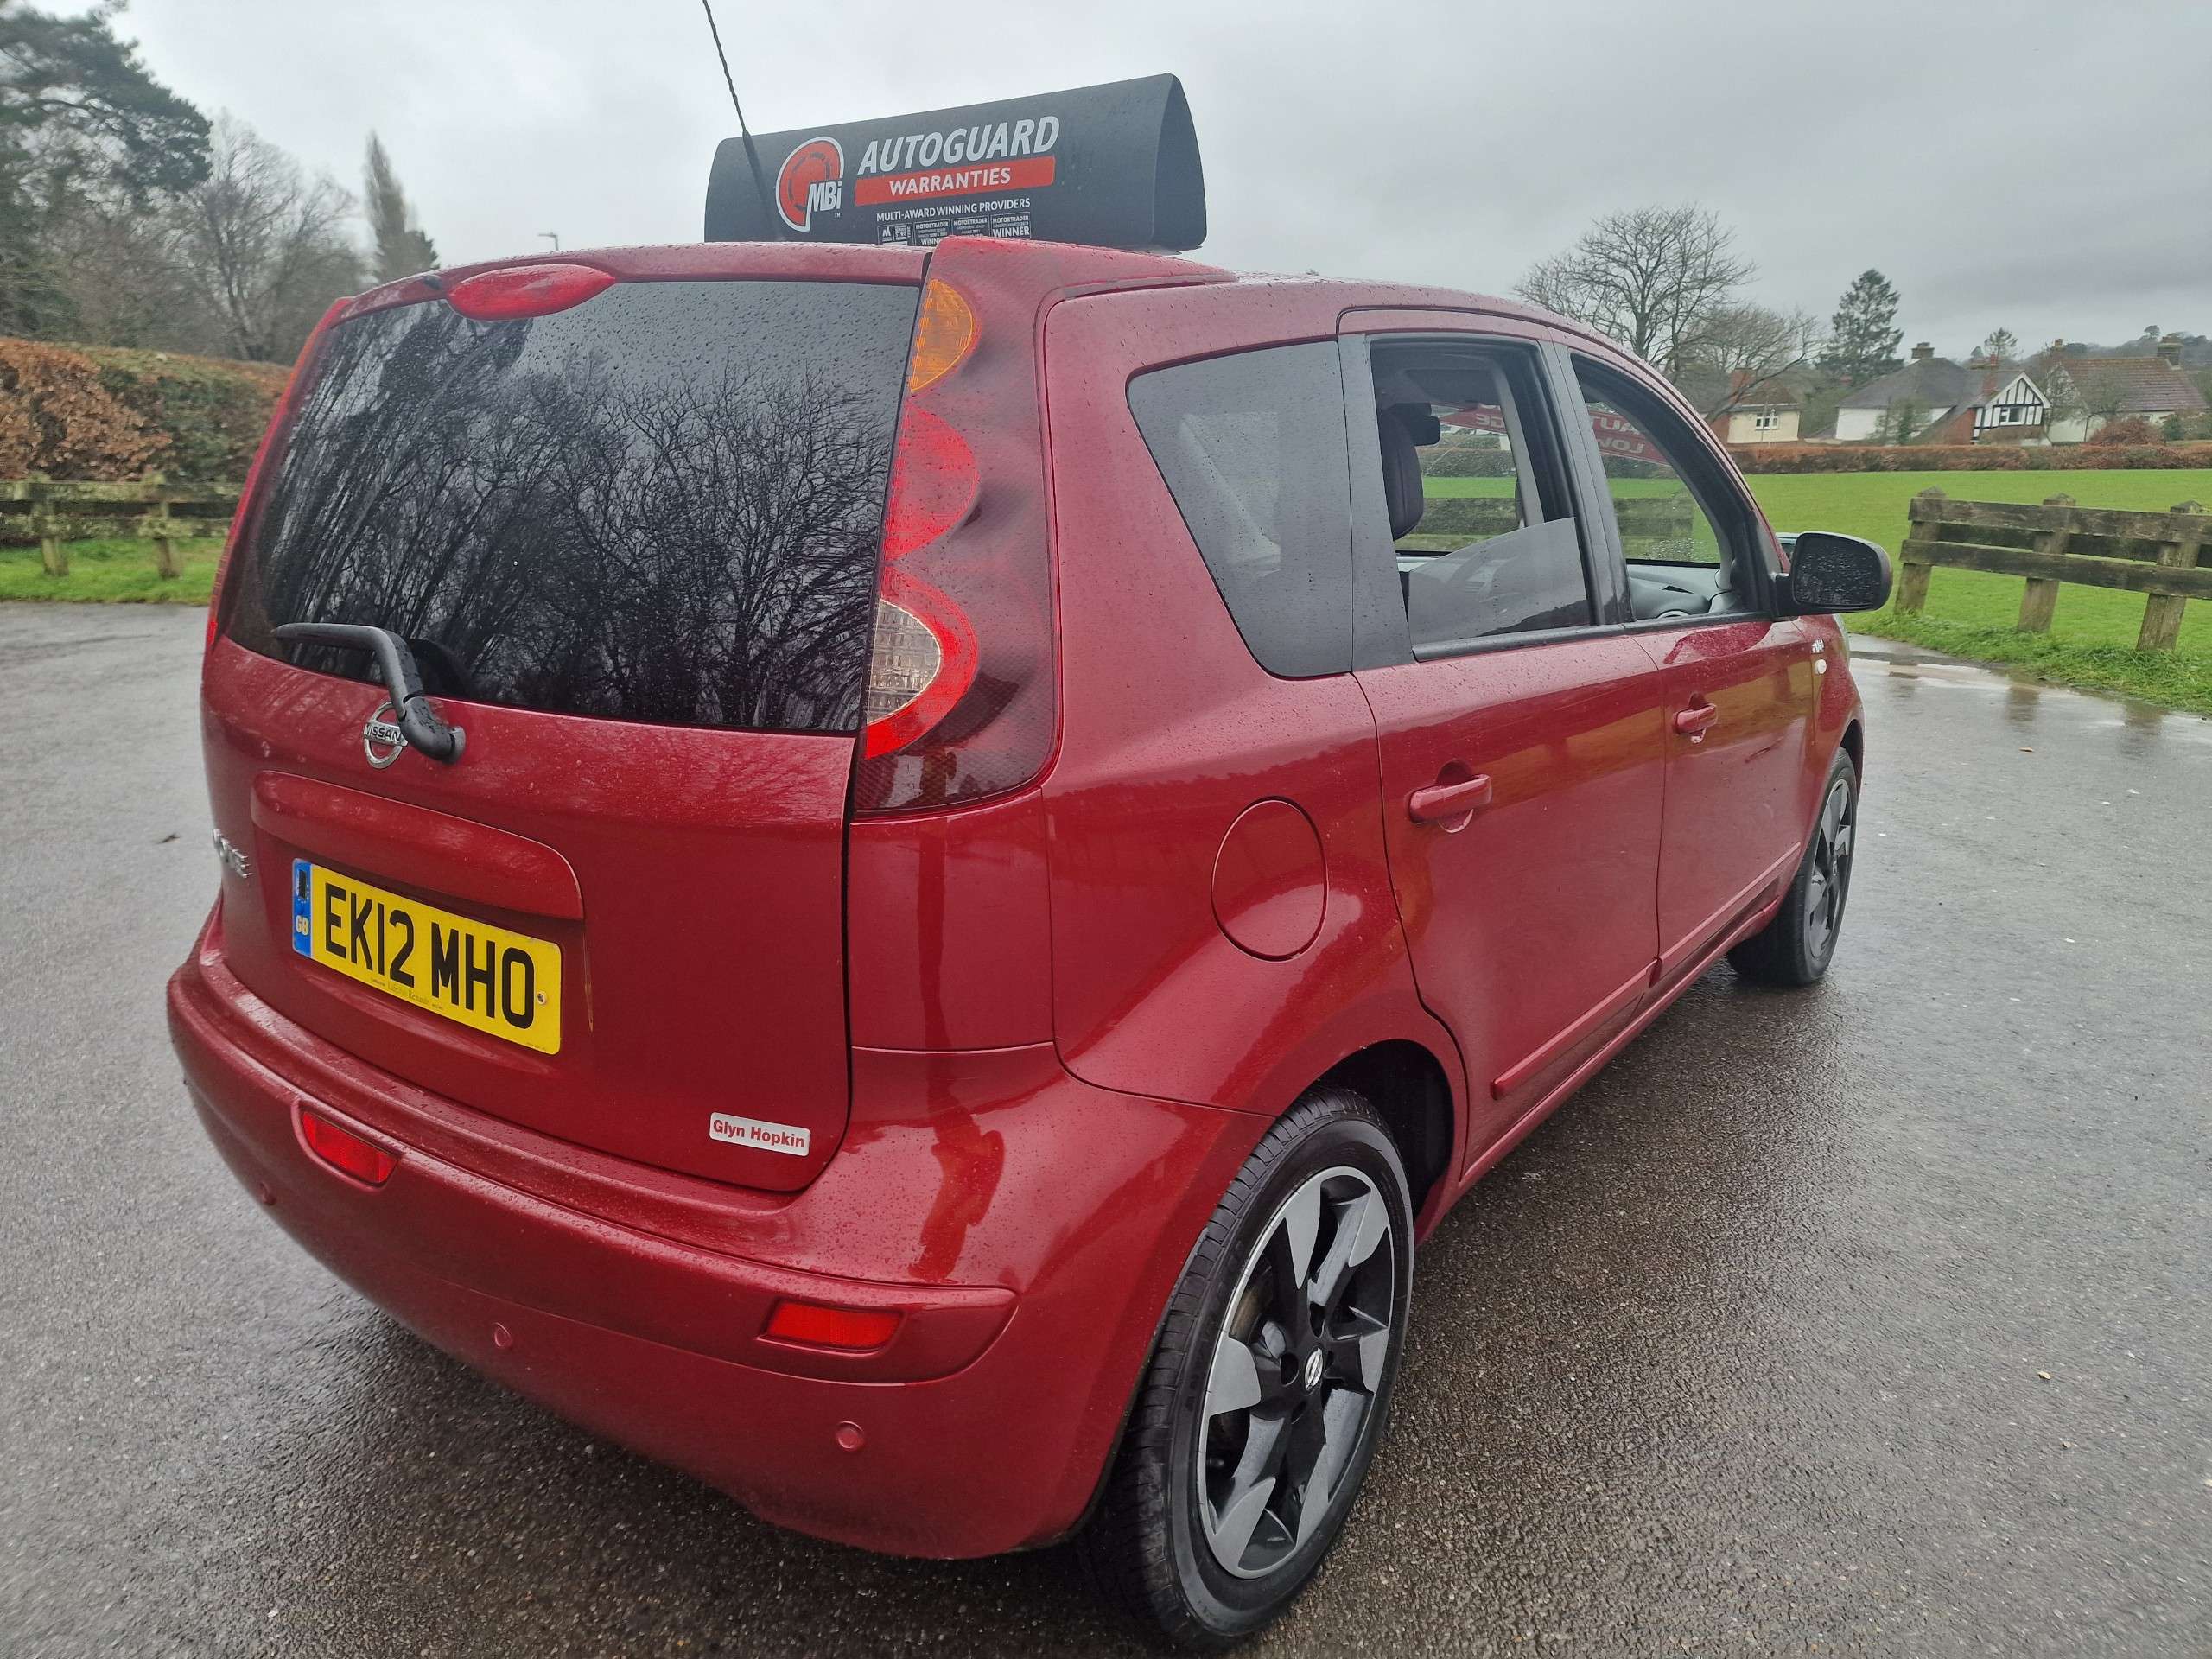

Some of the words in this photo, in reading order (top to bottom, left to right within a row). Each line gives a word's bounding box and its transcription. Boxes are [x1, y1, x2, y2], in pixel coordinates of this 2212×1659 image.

[857, 116, 1059, 175] AUTOGUARD
[889, 168, 1011, 196] WARRANTIES
[876, 208, 936, 222] MULTI-AWARD
[938, 203, 978, 217] WINNING
[979, 198, 1031, 212] PROVIDERS
[993, 226, 1030, 238] WINNER
[364, 722, 402, 741] NISSAN
[296, 915, 309, 936] GB
[325, 882, 415, 988] EK12
[431, 922, 535, 1029] MHO
[713, 1119, 745, 1138] Glyn
[750, 1126, 804, 1147] Hopkin
